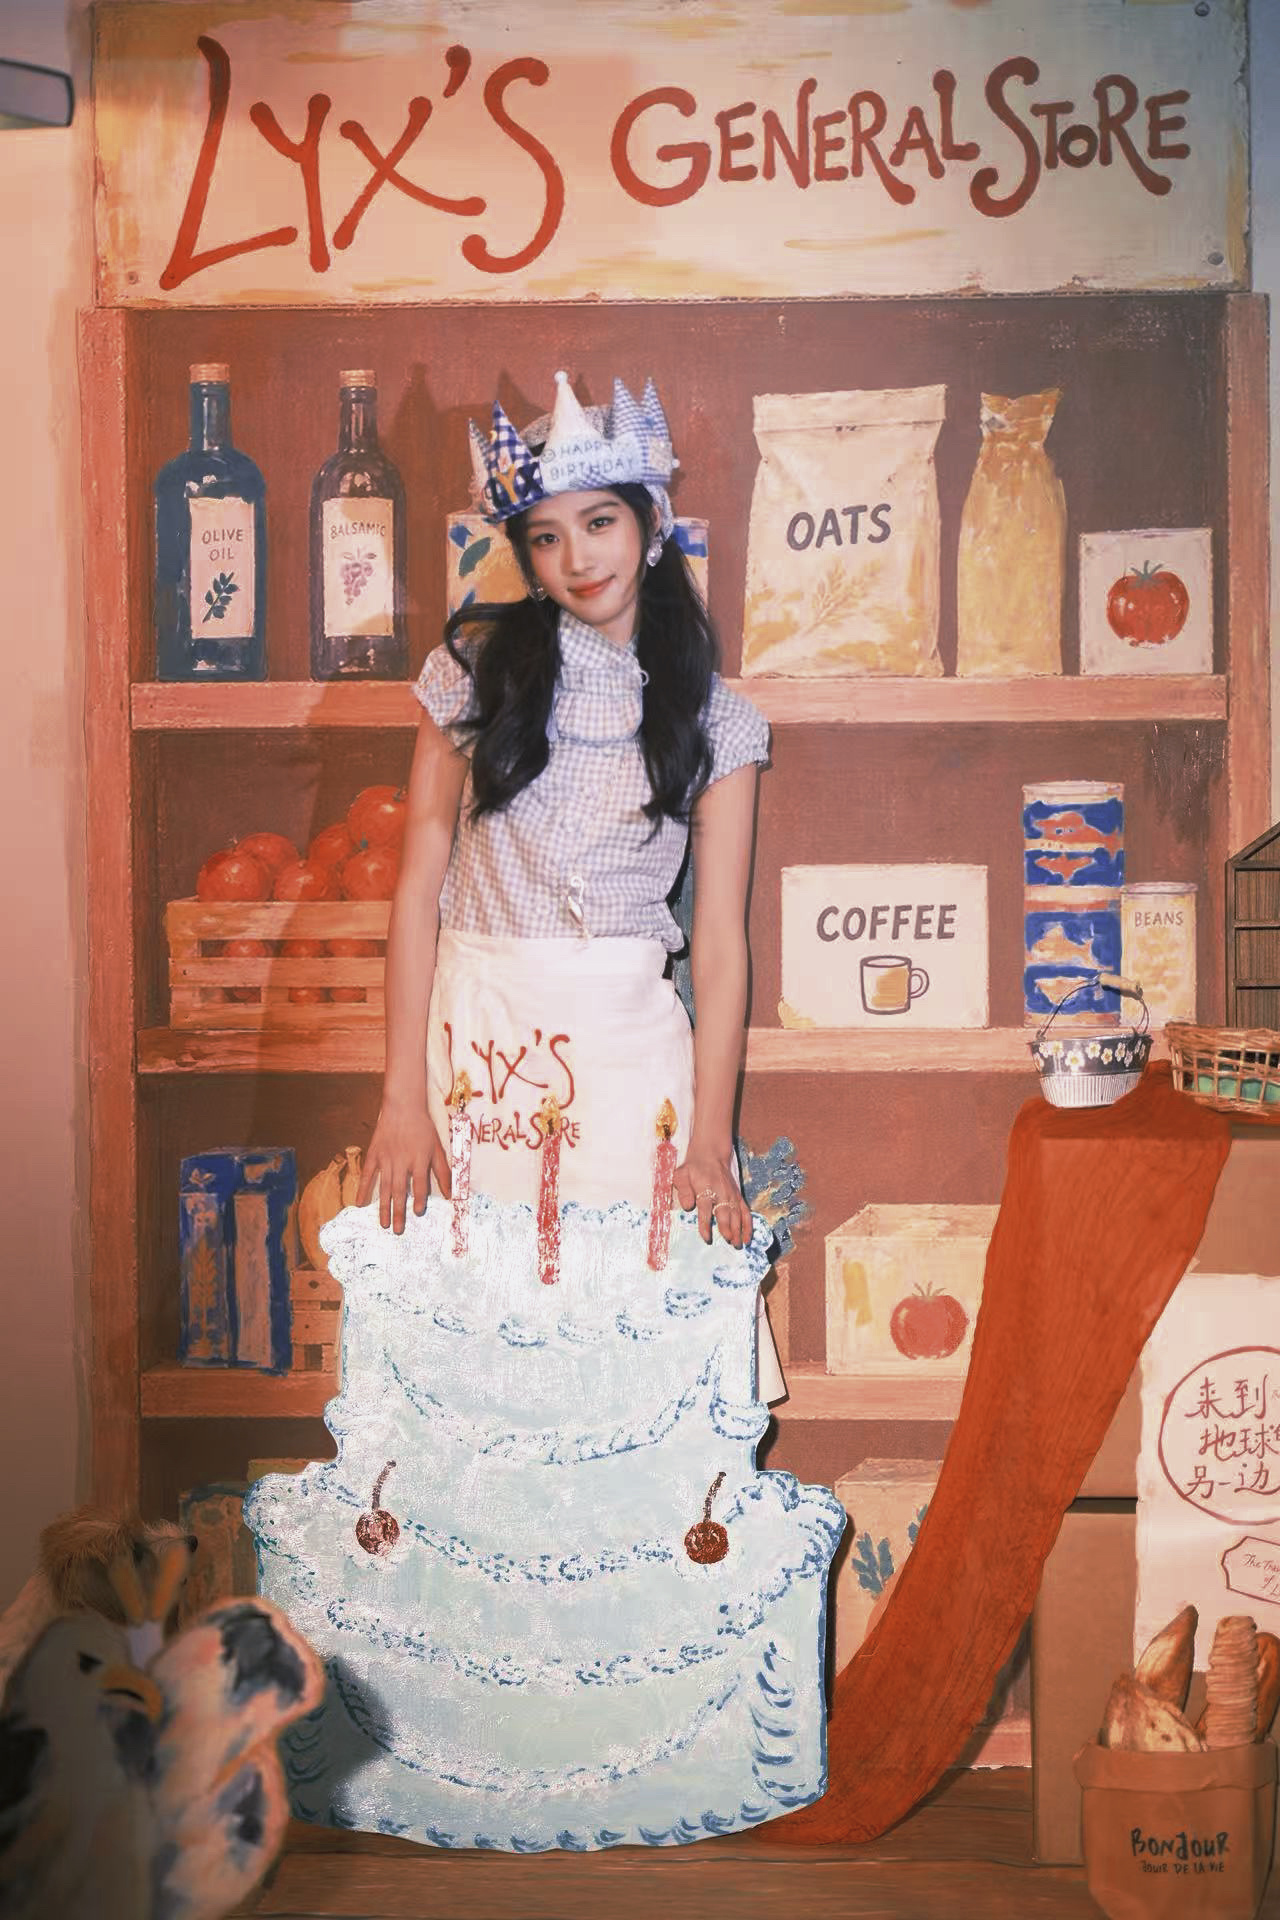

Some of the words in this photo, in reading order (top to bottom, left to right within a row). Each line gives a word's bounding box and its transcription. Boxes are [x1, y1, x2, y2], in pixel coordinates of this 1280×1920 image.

[159, 35, 565, 291] LYX'S
[610, 69, 980, 207] GENERAL
[969, 56, 1191, 218] STORE
[550, 457, 634, 481] BIRTHDAY
[202, 528, 243, 545] OLIVE
[330, 521, 386, 540] BALSAMIC
[787, 503, 892, 551] OATS
[209, 547, 235, 561] OIL
[816, 904, 958, 942] COFFEE
[1135, 911, 1184, 928] BEANS
[525, 1112, 582, 1150] SRE
[1184, 1374, 1269, 1419] 来到
[1199, 1423, 1280, 1462] 地球
[1184, 1460, 1280, 1499] 另一边
